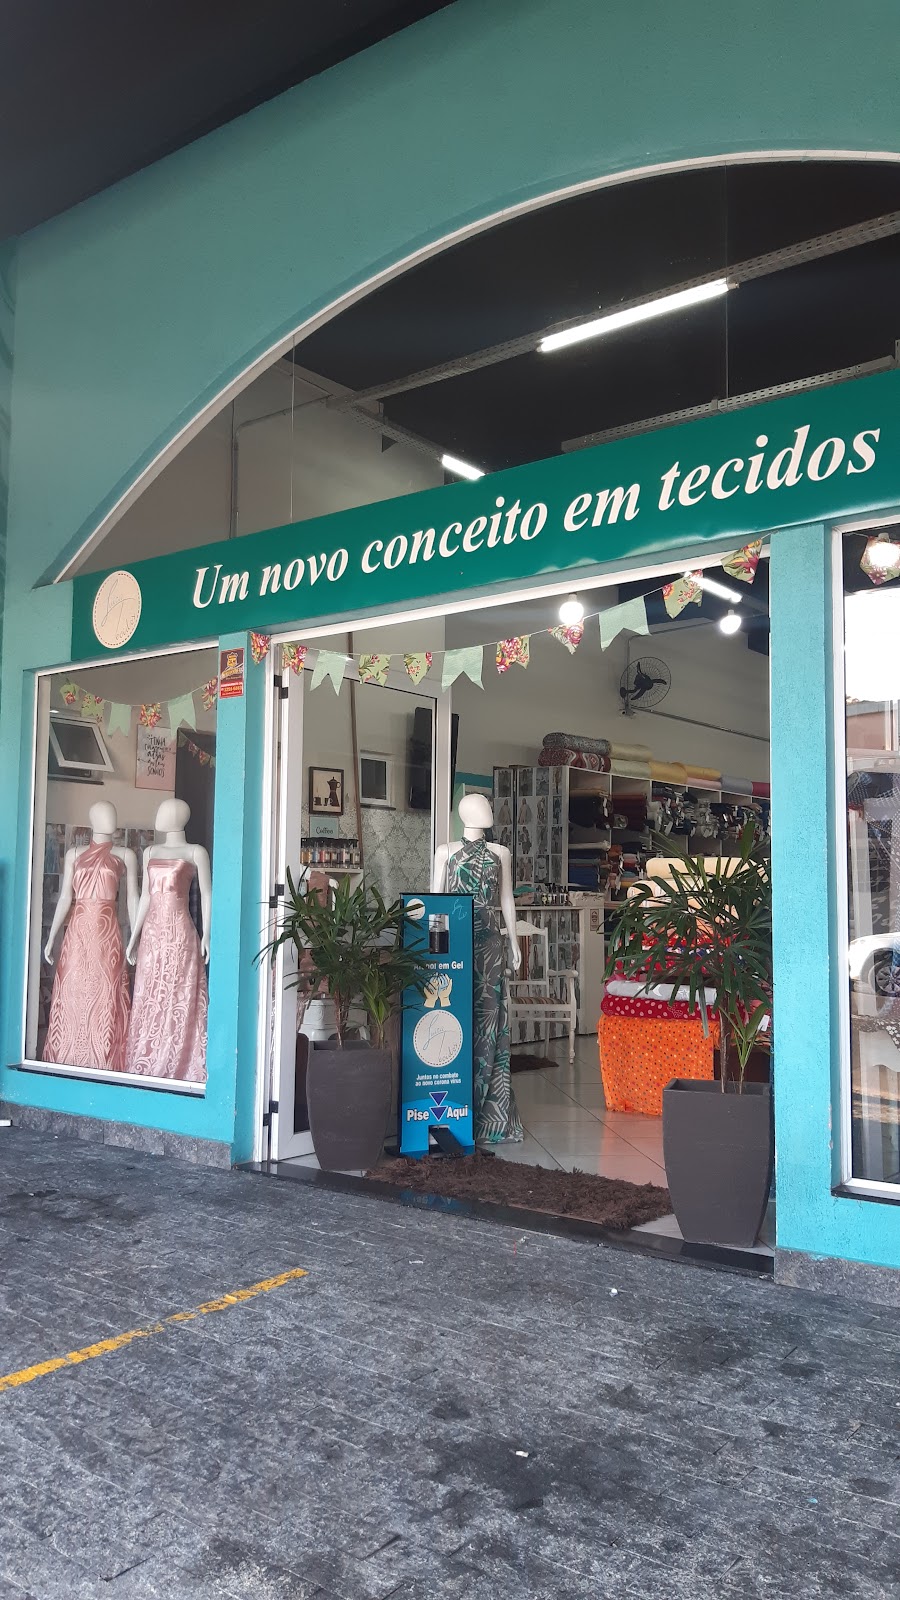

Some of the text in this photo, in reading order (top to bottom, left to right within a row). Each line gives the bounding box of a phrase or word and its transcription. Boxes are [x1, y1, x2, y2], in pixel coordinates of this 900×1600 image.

[192, 428, 881, 609] Um novo conceito em tecidos
[451, 960, 464, 970] Gel
[407, 1105, 469, 1121] Pise Aqui
